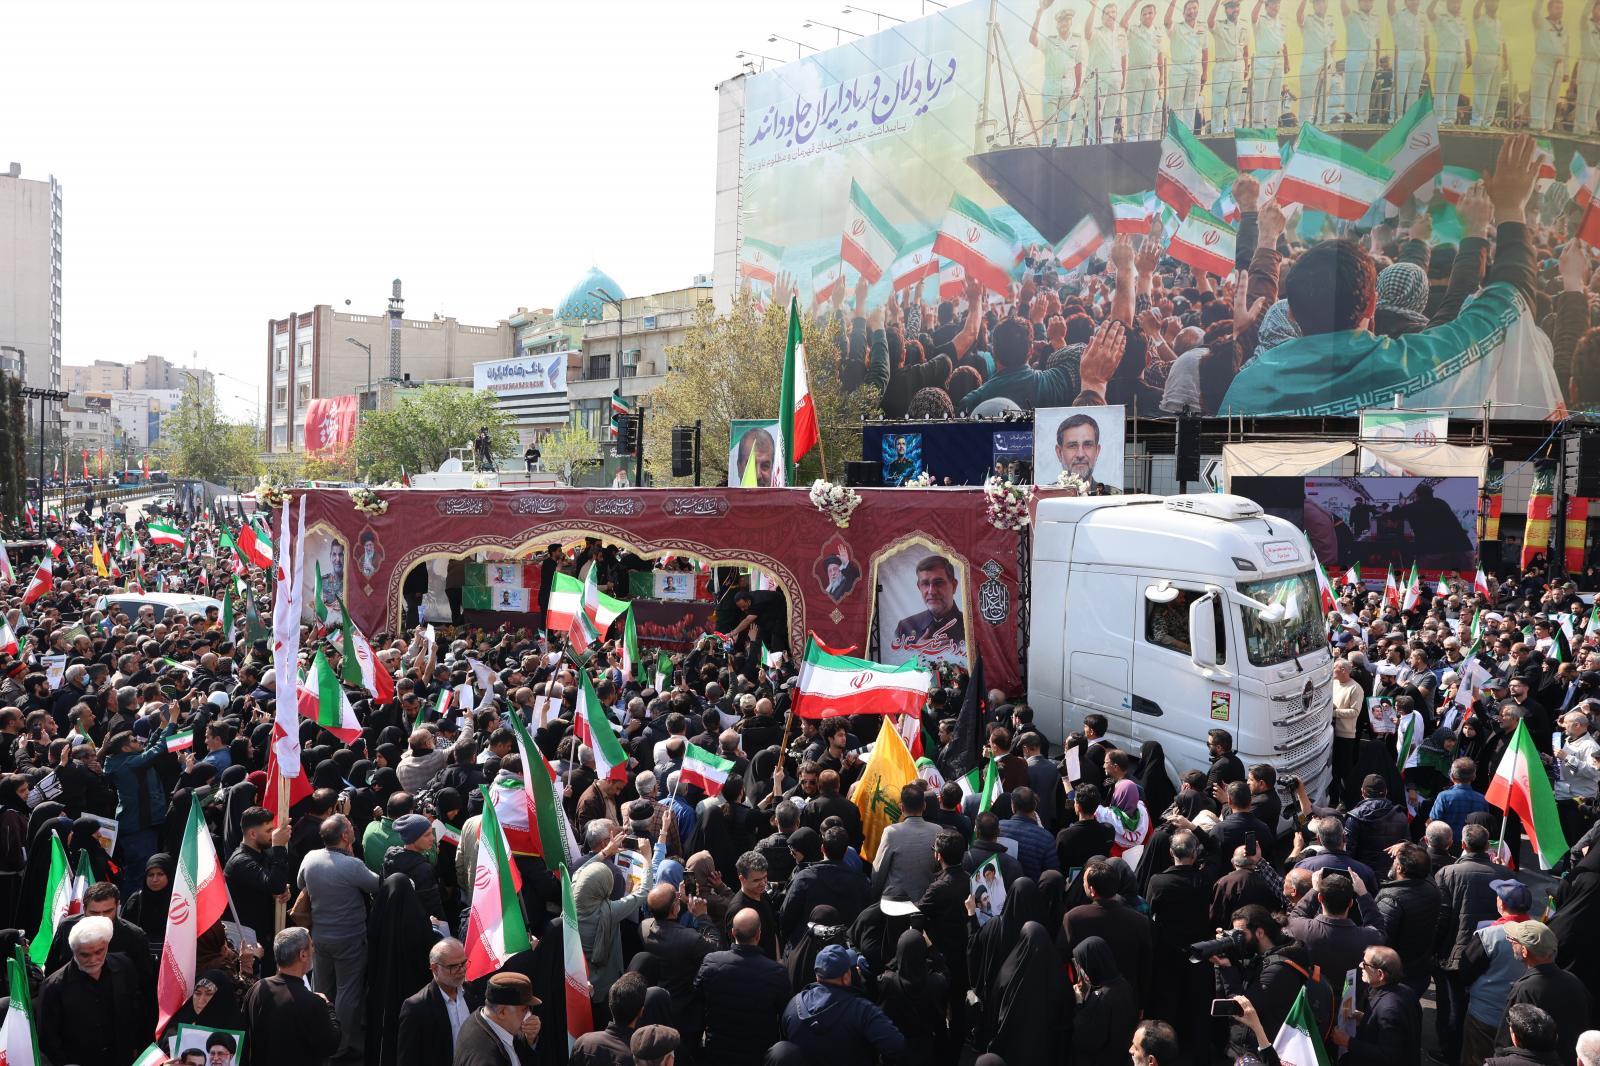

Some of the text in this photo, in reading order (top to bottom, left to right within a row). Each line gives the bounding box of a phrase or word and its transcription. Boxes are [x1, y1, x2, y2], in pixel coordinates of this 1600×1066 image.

[748, 94, 812, 147] جاودانند
[487, 361, 544, 381] بانک رفاه کارگران
